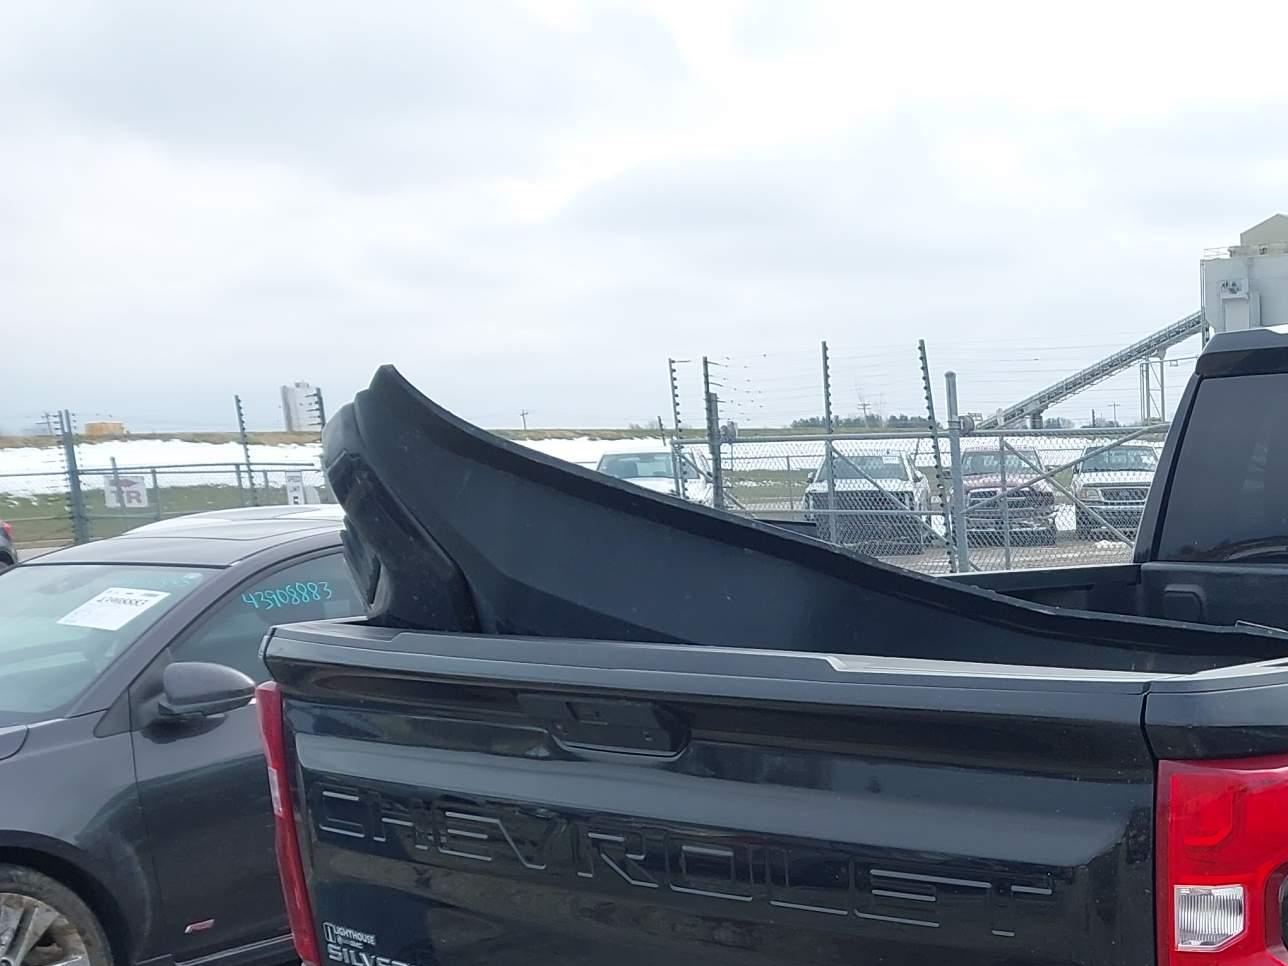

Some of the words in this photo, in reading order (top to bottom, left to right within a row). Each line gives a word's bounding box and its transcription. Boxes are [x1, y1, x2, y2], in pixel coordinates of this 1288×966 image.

[241, 581, 332, 610] 43908883
[318, 784, 1055, 938] CHEVROLET
[334, 926, 377, 945] LIGHTHOUSE
